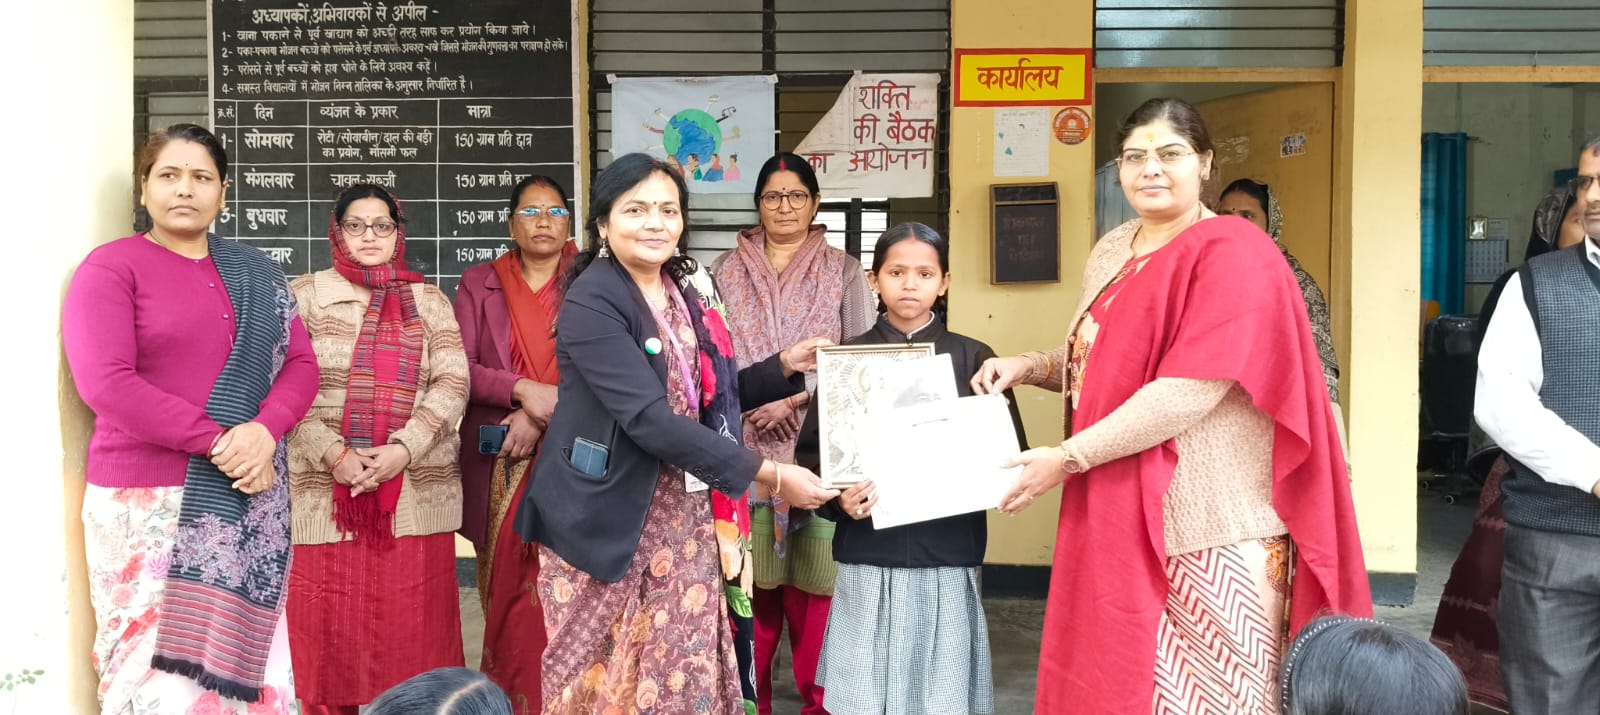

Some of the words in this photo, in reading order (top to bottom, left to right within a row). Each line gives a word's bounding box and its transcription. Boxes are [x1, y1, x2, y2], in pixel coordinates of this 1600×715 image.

[375, 2, 388, 22] से
[392, 1, 428, 22] अपील
[236, 30, 258, 41] खाना
[261, 27, 290, 41] पकाने
[293, 26, 302, 39] से
[308, 27, 321, 41] पूर्व
[356, 25, 369, 38] को
[399, 26, 418, 40] तरह
[420, 26, 438, 38] साफ
[440, 26, 455, 37] कर
[458, 23, 482, 36] प्रयोग
[485, 22, 508, 36] किया
[511, 21, 530, 36] जाये
[238, 62, 261, 76] परोसने
[264, 62, 272, 75] से
[274, 59, 286, 76] पूर्व
[287, 61, 309, 75] बच्चों
[311, 61, 321, 74] को
[359, 60, 368, 73] के
[369, 59, 384, 73] लिये
[388, 61, 412, 73] अवश्य
[976, 57, 1064, 92] कार्यालय
[236, 82, 260, 94] समस्त
[263, 79, 297, 93] विद्यालयों
[300, 79, 308, 92] में
[354, 77, 382, 92] तालिका
[384, 77, 395, 90] के
[395, 79, 423, 95] अनुसार
[426, 77, 457, 91] निर्धारित
[458, 75, 467, 93] है
[858, 80, 916, 111] शक्ति
[253, 103, 274, 120] दिन
[319, 103, 351, 119] व्यंजन
[354, 102, 366, 117] के
[369, 105, 399, 120] प्रकार
[466, 105, 493, 119] मात्रा
[854, 114, 881, 144] की
[887, 111, 935, 144] बैठक
[244, 129, 295, 150] सोमवार
[317, 129, 335, 144] रोटी
[402, 129, 414, 143] की
[416, 130, 433, 146] बड़ी
[455, 133, 474, 148] 150
[476, 133, 495, 147] ग्राम
[497, 129, 513, 147] प्रति
[322, 147, 335, 158] का
[400, 147, 418, 159] फल
[848, 142, 932, 174] आयोजन
[243, 168, 296, 190] मंगलवार
[455, 174, 476, 188] 150
[478, 173, 496, 187] ग्राम
[498, 170, 513, 187] प्रति
[246, 208, 288, 230] बुधवार
[456, 210, 476, 225] 150
[477, 210, 495, 224] ग्राम
[456, 248, 475, 263] 150
[476, 248, 494, 263] ग्राम
